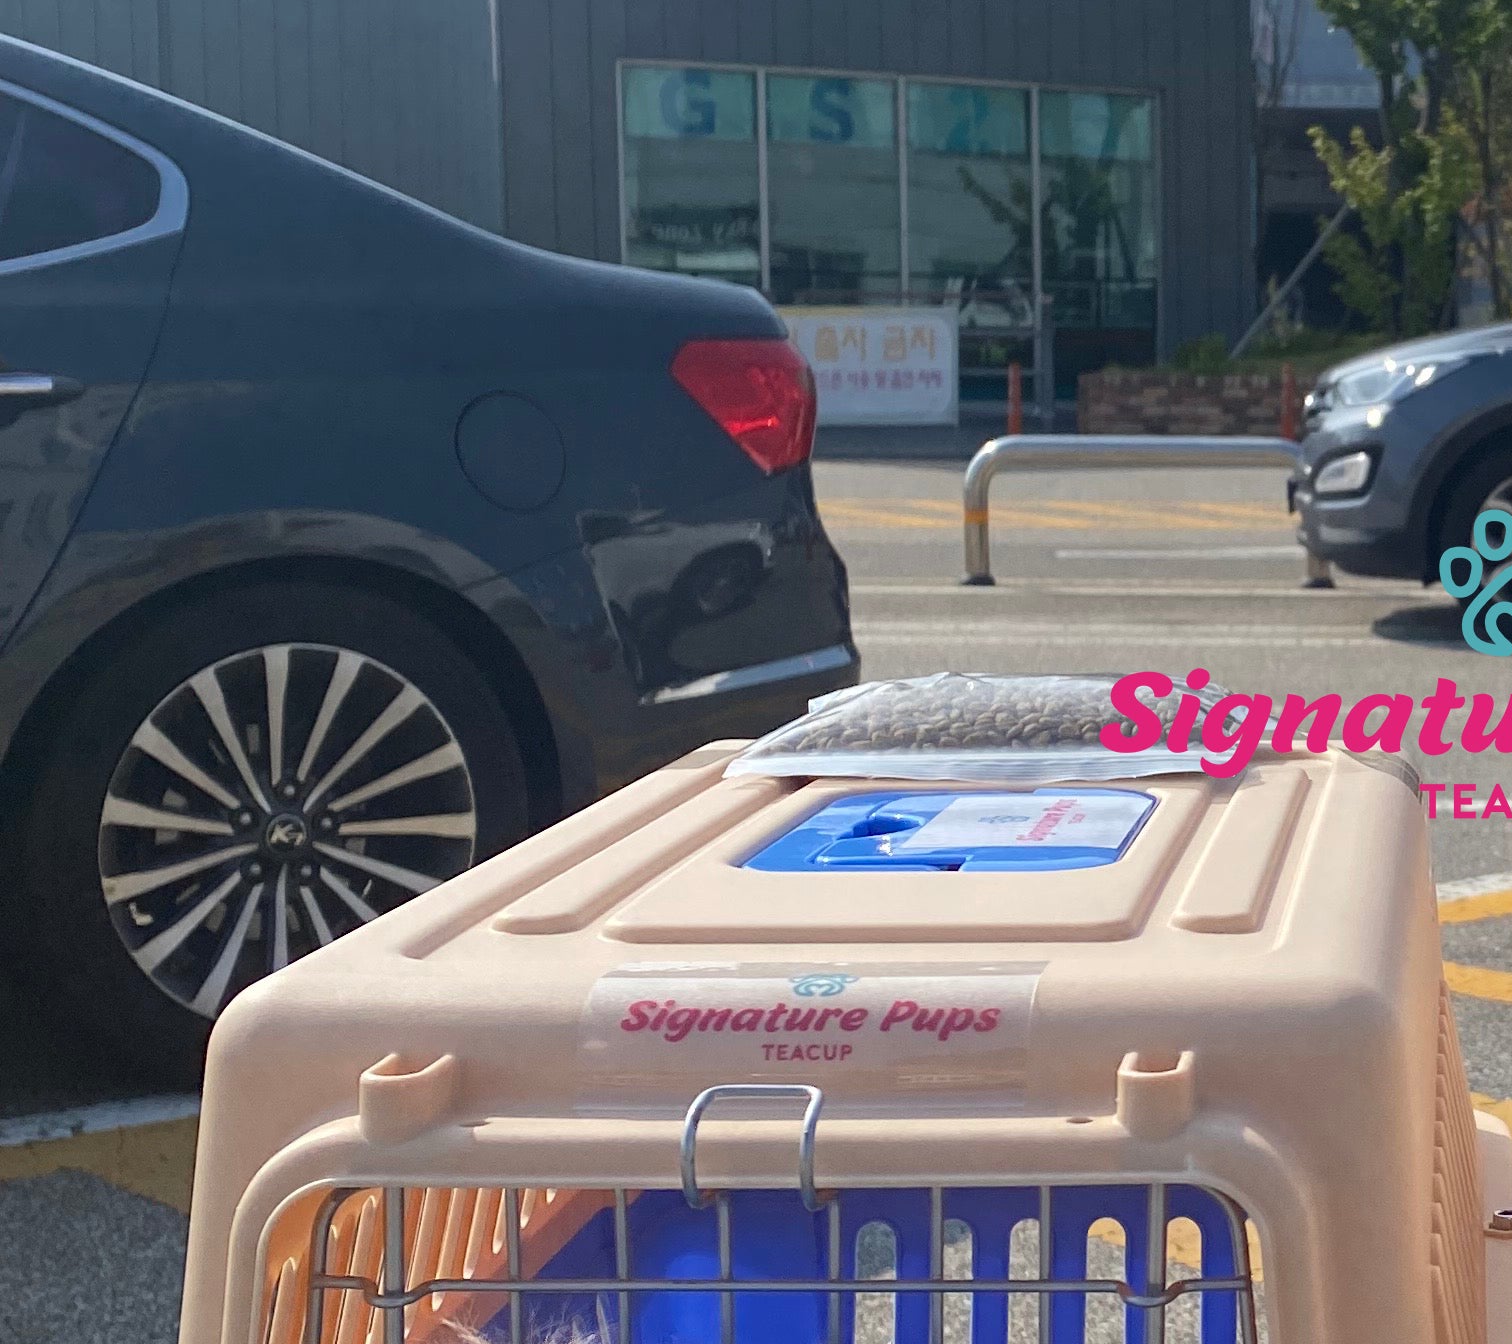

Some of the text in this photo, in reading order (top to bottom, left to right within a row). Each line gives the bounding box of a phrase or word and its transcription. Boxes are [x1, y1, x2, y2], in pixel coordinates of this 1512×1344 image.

[620, 1000, 1001, 1042] Signature Pups
[761, 1044, 853, 1061] TEACUP
